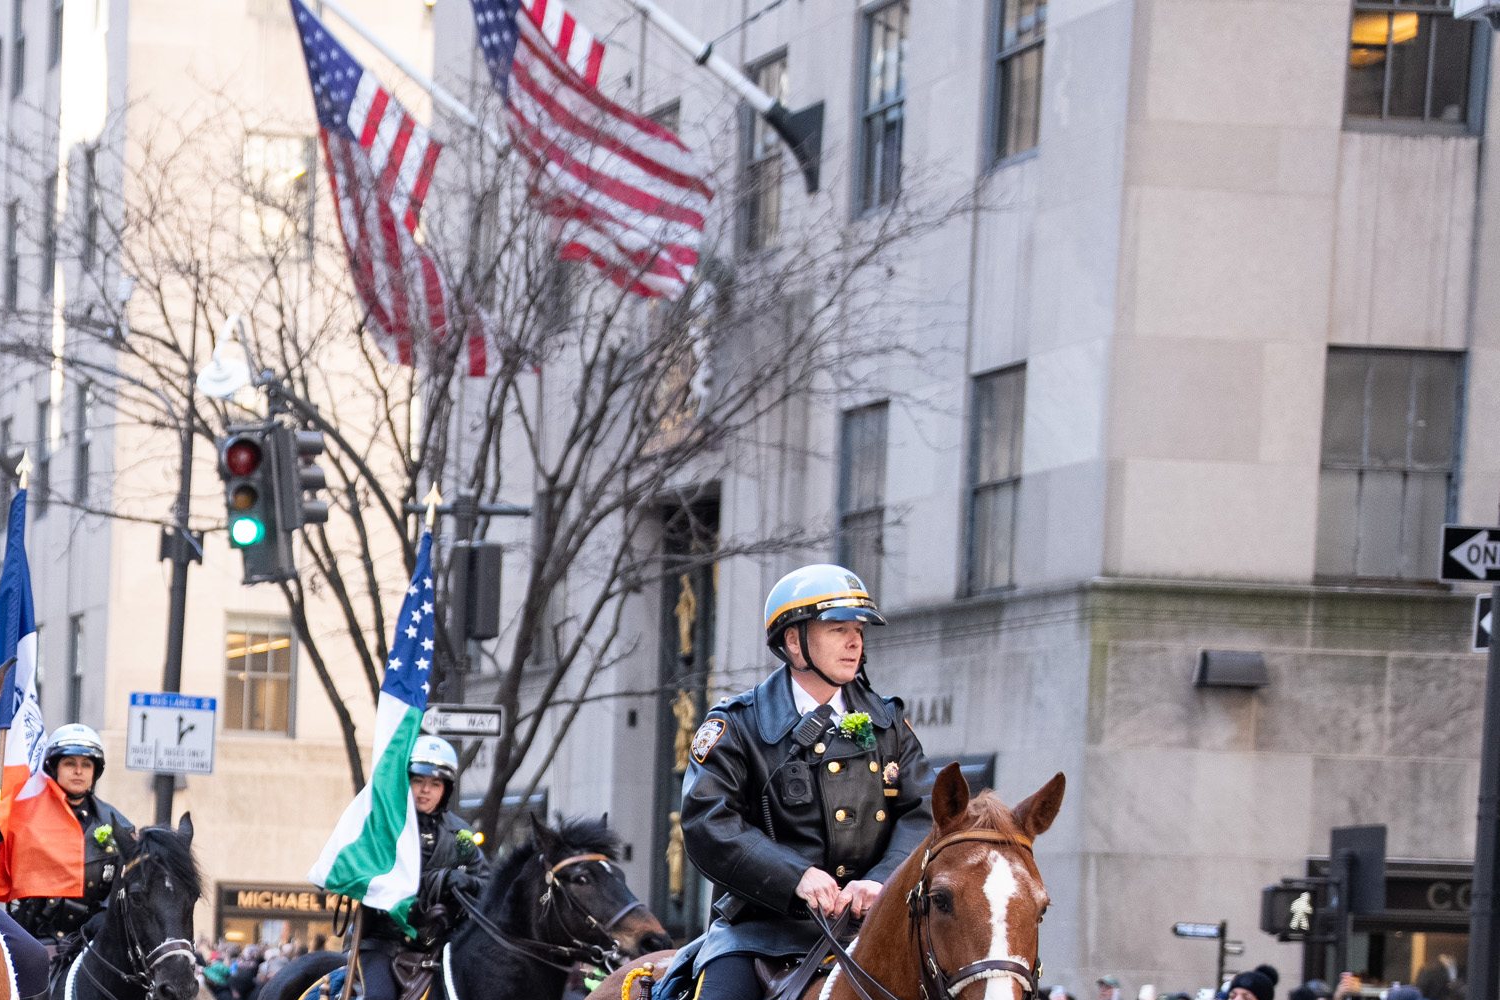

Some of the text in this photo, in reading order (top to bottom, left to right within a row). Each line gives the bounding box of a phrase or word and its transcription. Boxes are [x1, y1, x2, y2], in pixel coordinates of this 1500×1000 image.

[1467, 542, 1500, 566] ON
[425, 713, 495, 729] ONE WAY
[237, 890, 321, 912] MICHAEL
